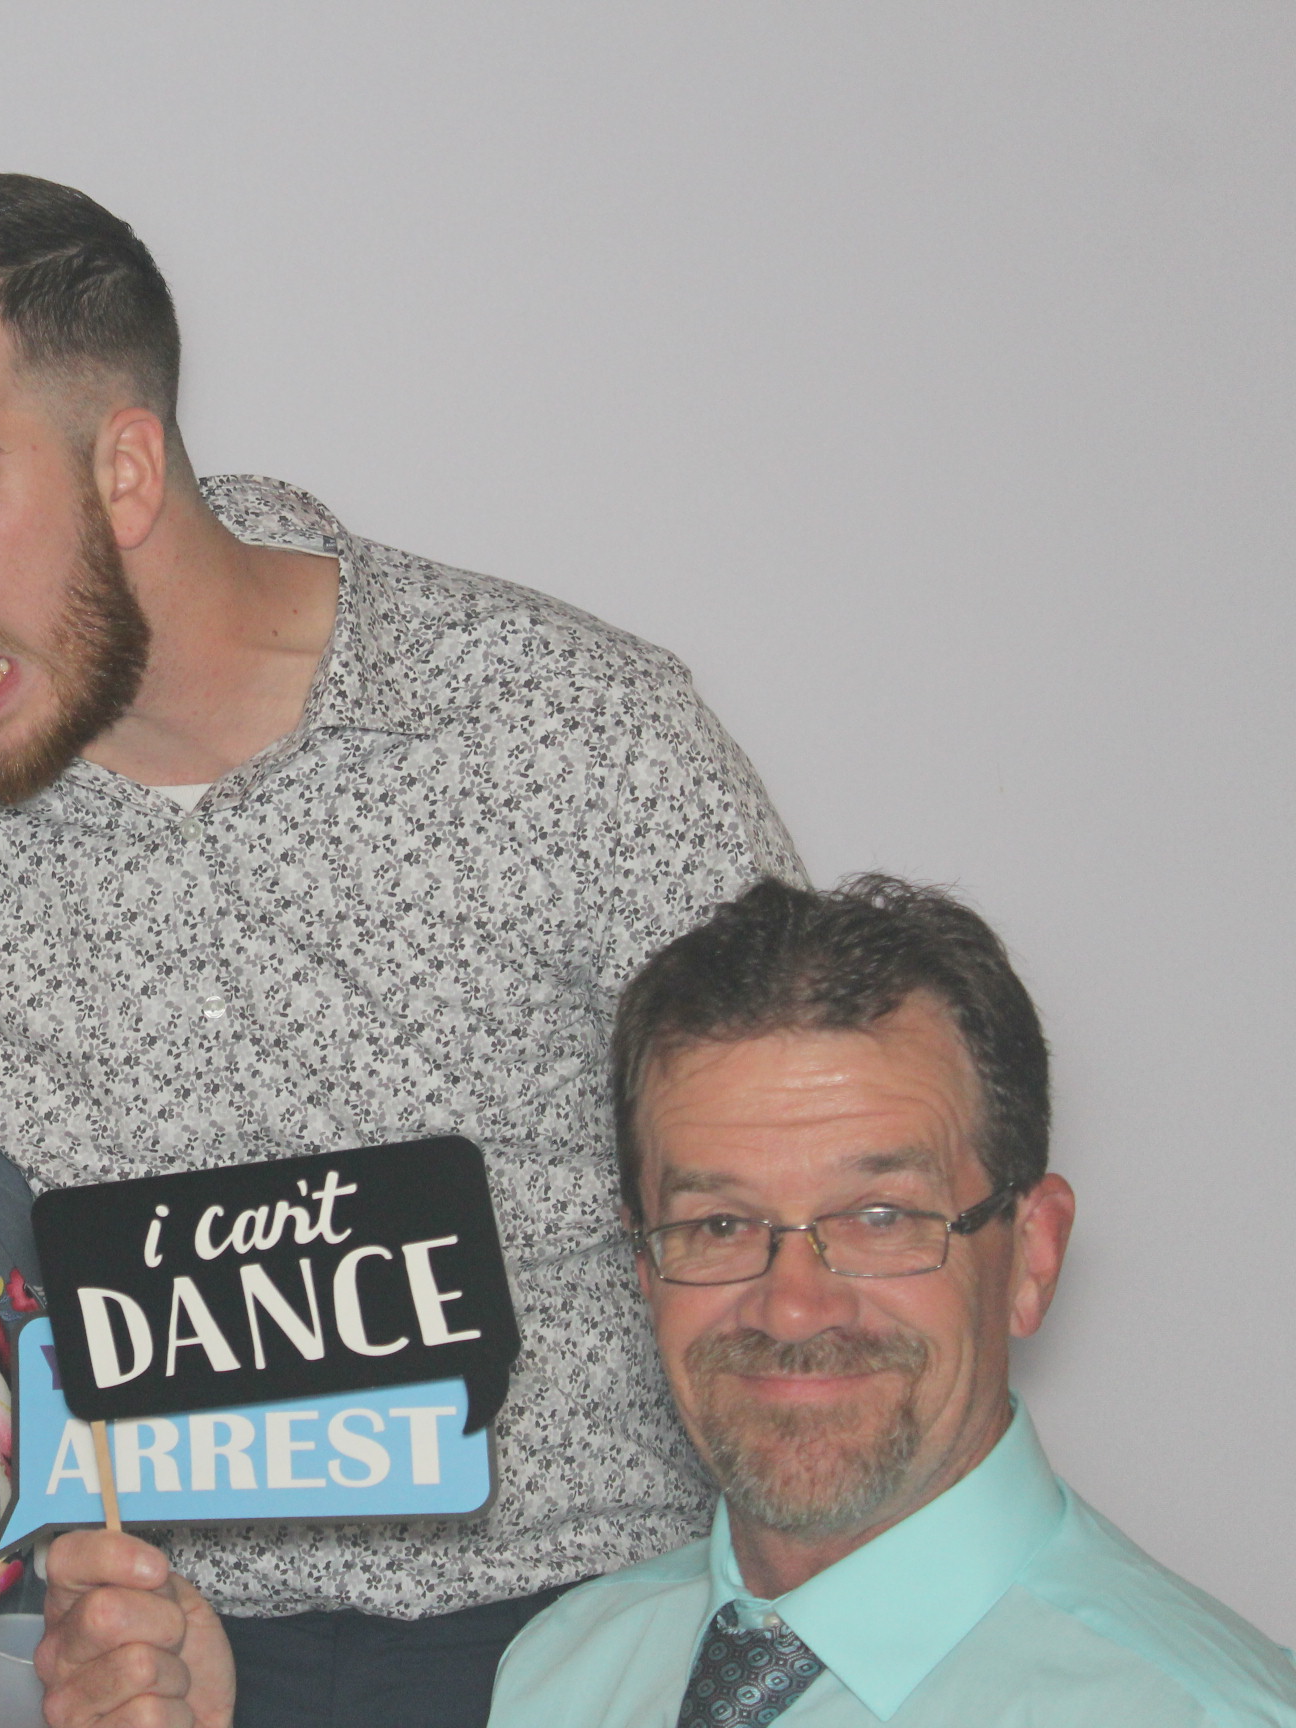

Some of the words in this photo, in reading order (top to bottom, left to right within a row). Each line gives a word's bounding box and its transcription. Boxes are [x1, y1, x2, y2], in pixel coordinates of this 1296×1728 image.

[144, 1205, 170, 1268] i
[194, 1171, 358, 1260] can't
[77, 1235, 482, 1389] DANCE
[46, 1406, 457, 1495] ARREST
